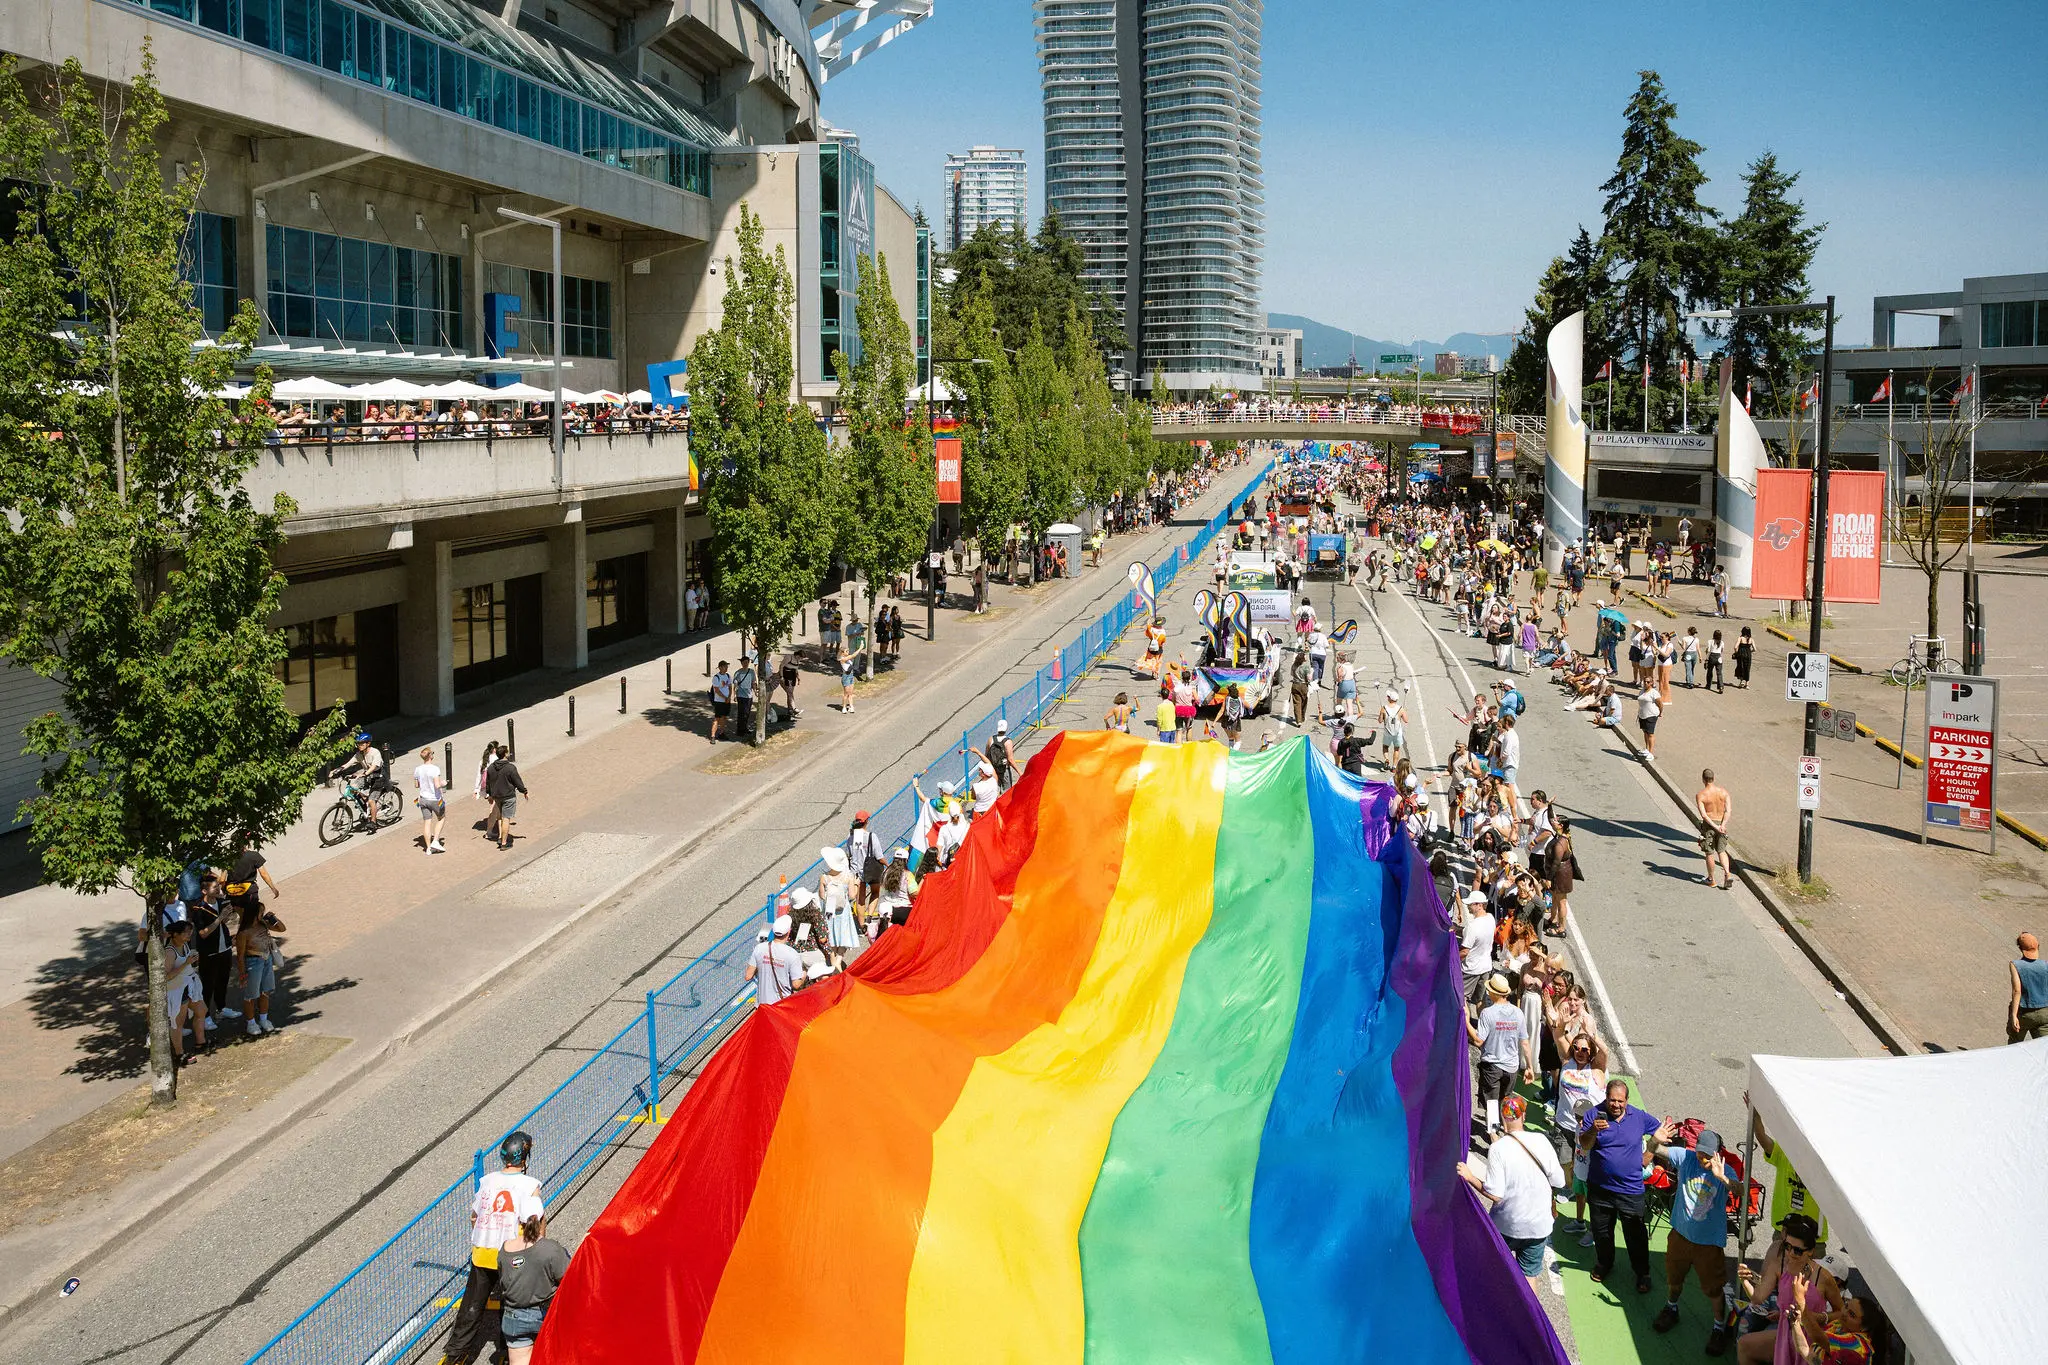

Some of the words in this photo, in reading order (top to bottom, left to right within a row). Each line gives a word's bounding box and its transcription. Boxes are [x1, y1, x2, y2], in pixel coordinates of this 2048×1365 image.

[846, 225, 870, 247] WHITECAPS
[1605, 435, 1635, 444] PLAZA
[1637, 436, 1651, 445] OF
[1652, 437, 1695, 447] NATIONS
[1832, 513, 1875, 534] ROAR
[1831, 533, 1849, 544] LIKE
[1851, 534, 1875, 544] NEVER
[1831, 543, 1875, 559] BEFORE
[1792, 679, 1823, 689] BEGINS
[1942, 710, 1980, 723] impark
[1933, 731, 1989, 745] PARKING
[1933, 761, 1954, 770] EASY
[1956, 763, 1989, 774] ACCESS
[1940, 769, 1962, 777] EASY
[1963, 771, 1981, 780] EXIT
[1946, 778, 1977, 787] HOURLY
[1946, 786, 1980, 796] STADIUM
[1946, 792, 1975, 801] EVENTS
